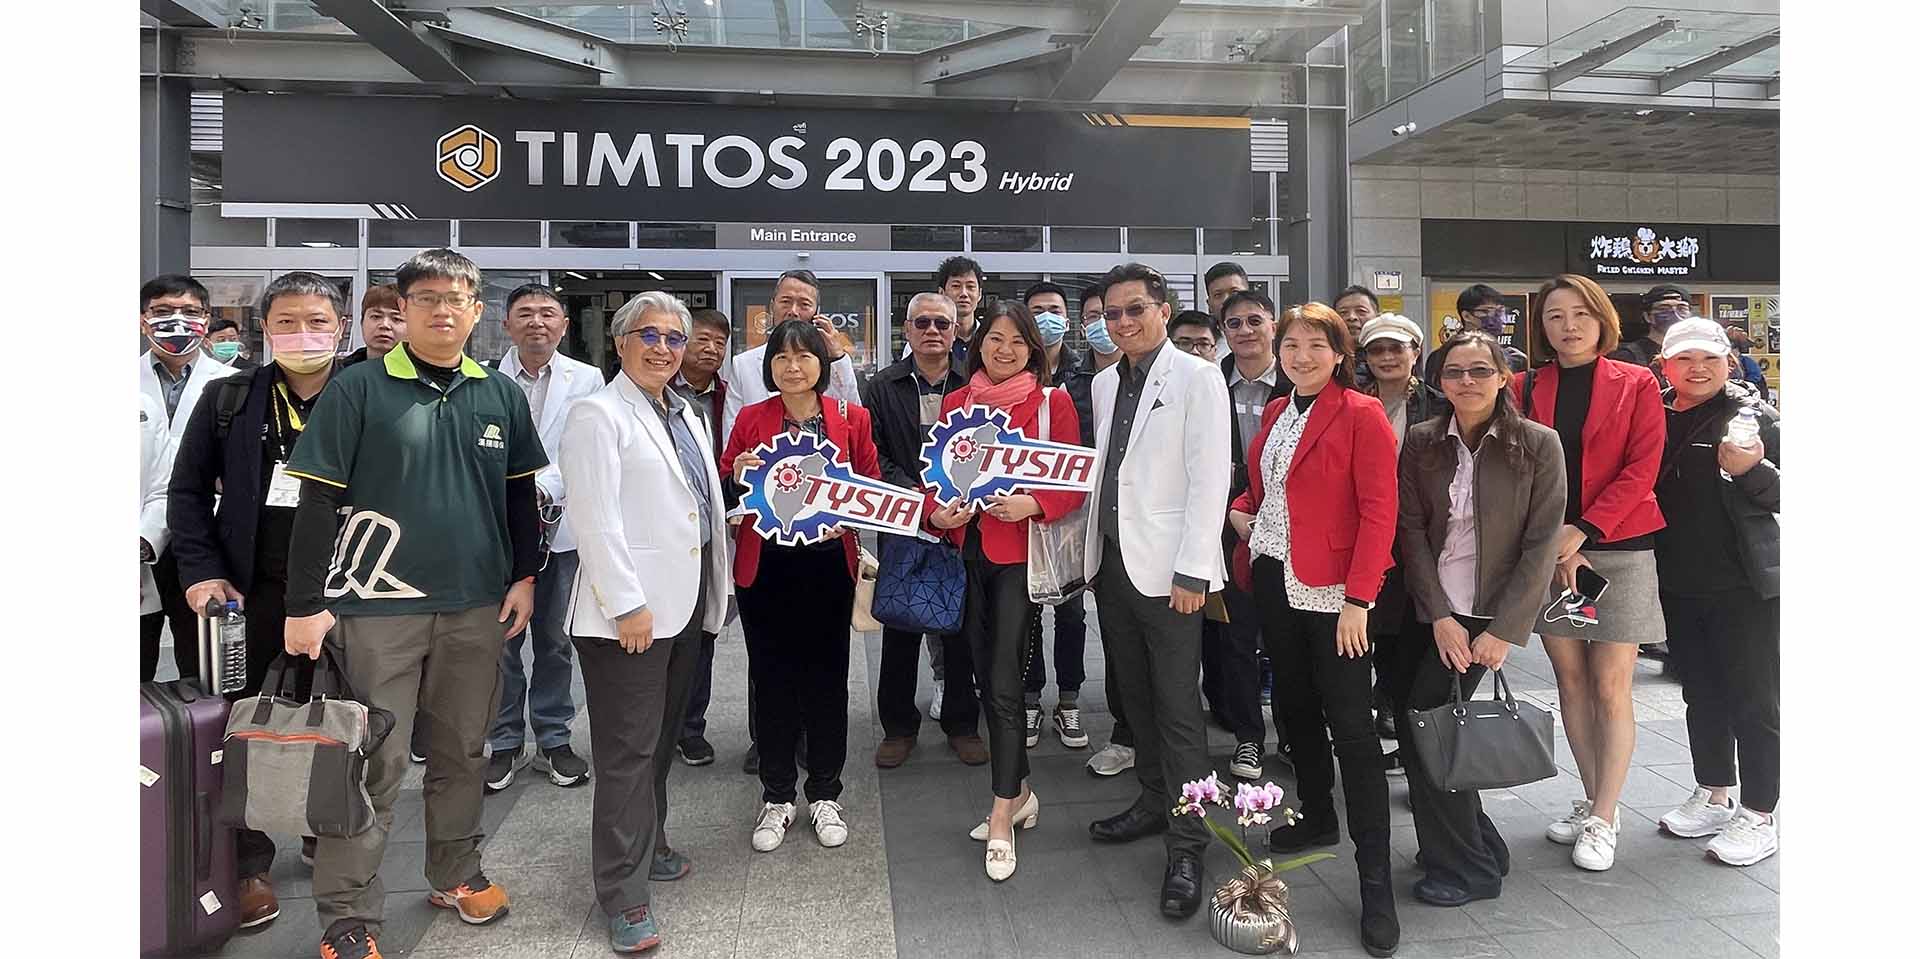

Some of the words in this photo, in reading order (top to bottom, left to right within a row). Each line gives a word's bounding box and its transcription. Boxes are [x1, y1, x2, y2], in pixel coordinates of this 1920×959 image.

[515, 130, 808, 191] TIMTOS
[824, 137, 988, 194] 2023
[998, 171, 1074, 195] Hybrid
[750, 228, 787, 241] Main
[791, 229, 857, 242] Entrance
[1657, 266, 1689, 275] MASTER
[1498, 336, 1512, 345] LIFE
[979, 445, 1096, 483] TYSIA
[802, 476, 921, 527] TYSIA
